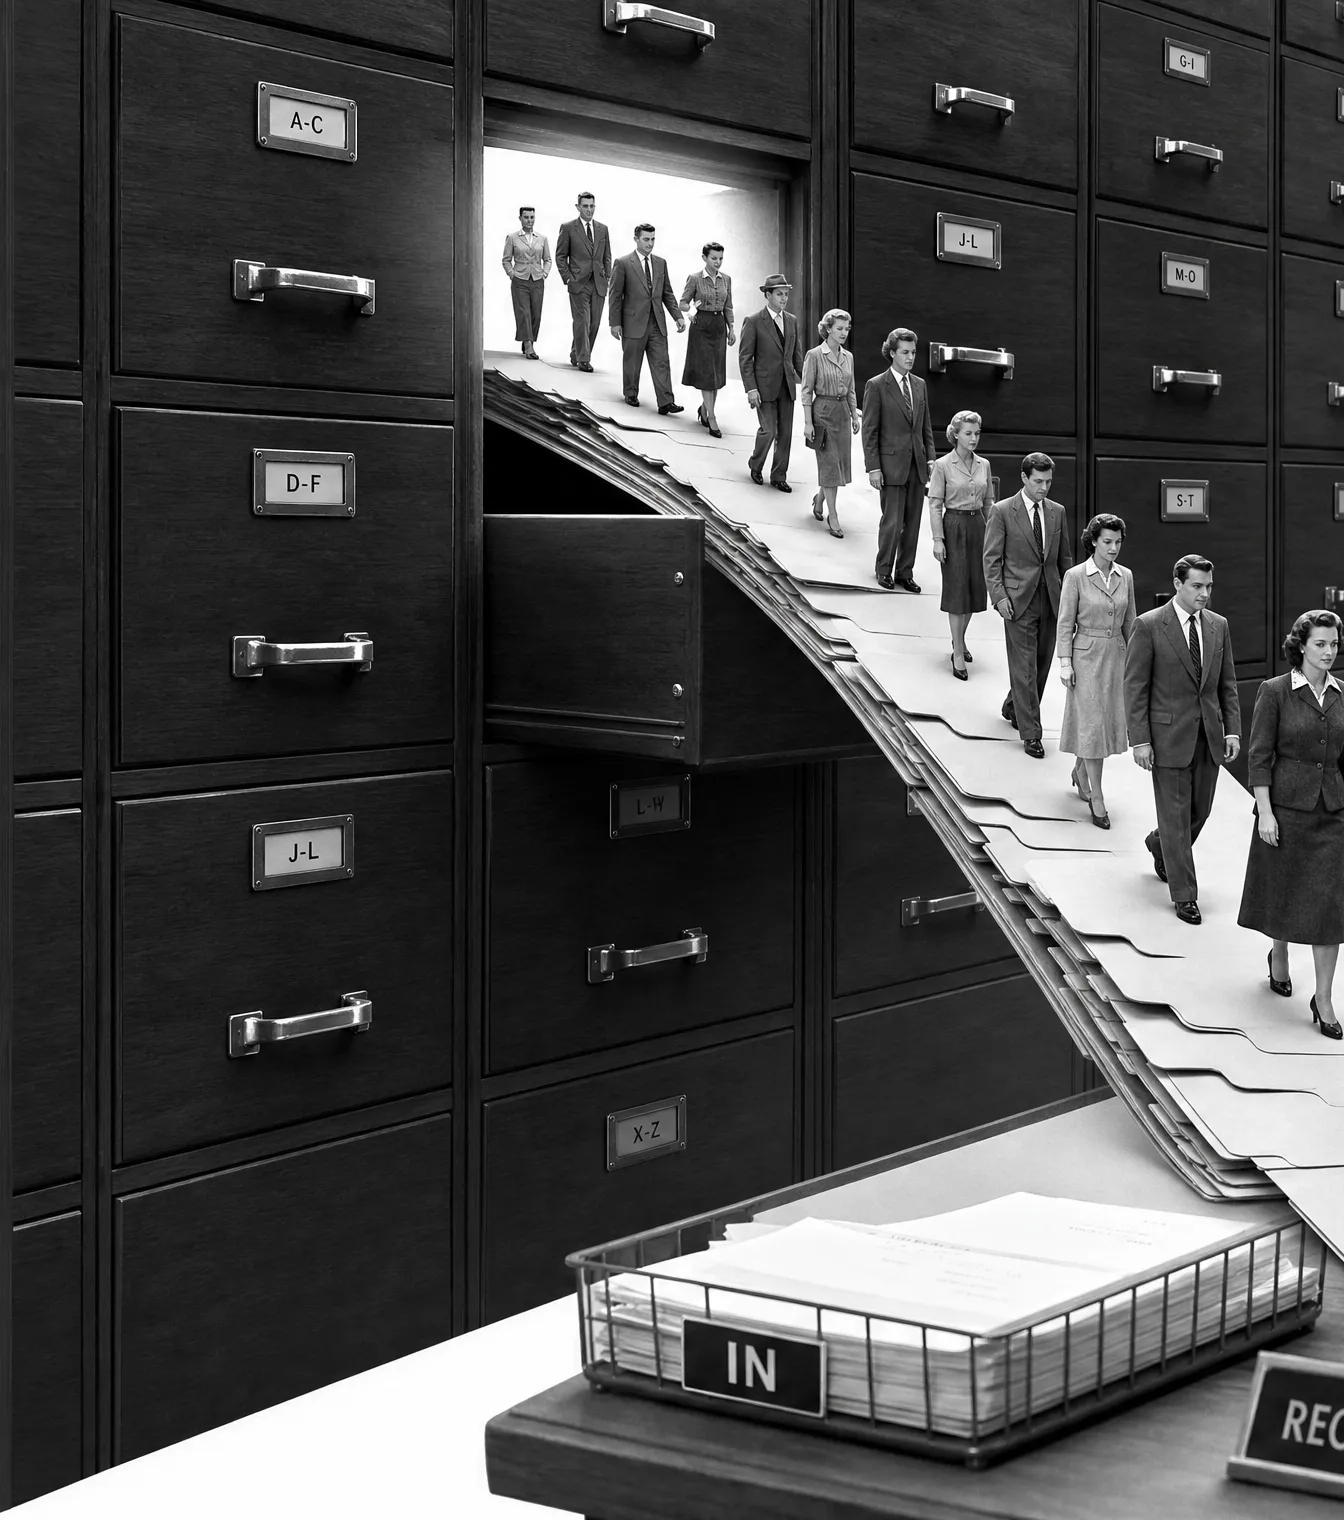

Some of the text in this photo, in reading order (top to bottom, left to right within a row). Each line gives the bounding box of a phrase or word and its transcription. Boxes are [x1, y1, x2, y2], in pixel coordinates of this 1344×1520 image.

[1180, 54, 1194, 70] G-I
[290, 111, 323, 134] A-C
[958, 232, 978, 249] J-L
[1176, 267, 1196, 283] M-O
[287, 473, 322, 493] D-F
[1177, 494, 1194, 507] S-T
[289, 841, 319, 863] J-L
[633, 1121, 660, 1144] X-Z
[728, 1340, 776, 1392] IN
